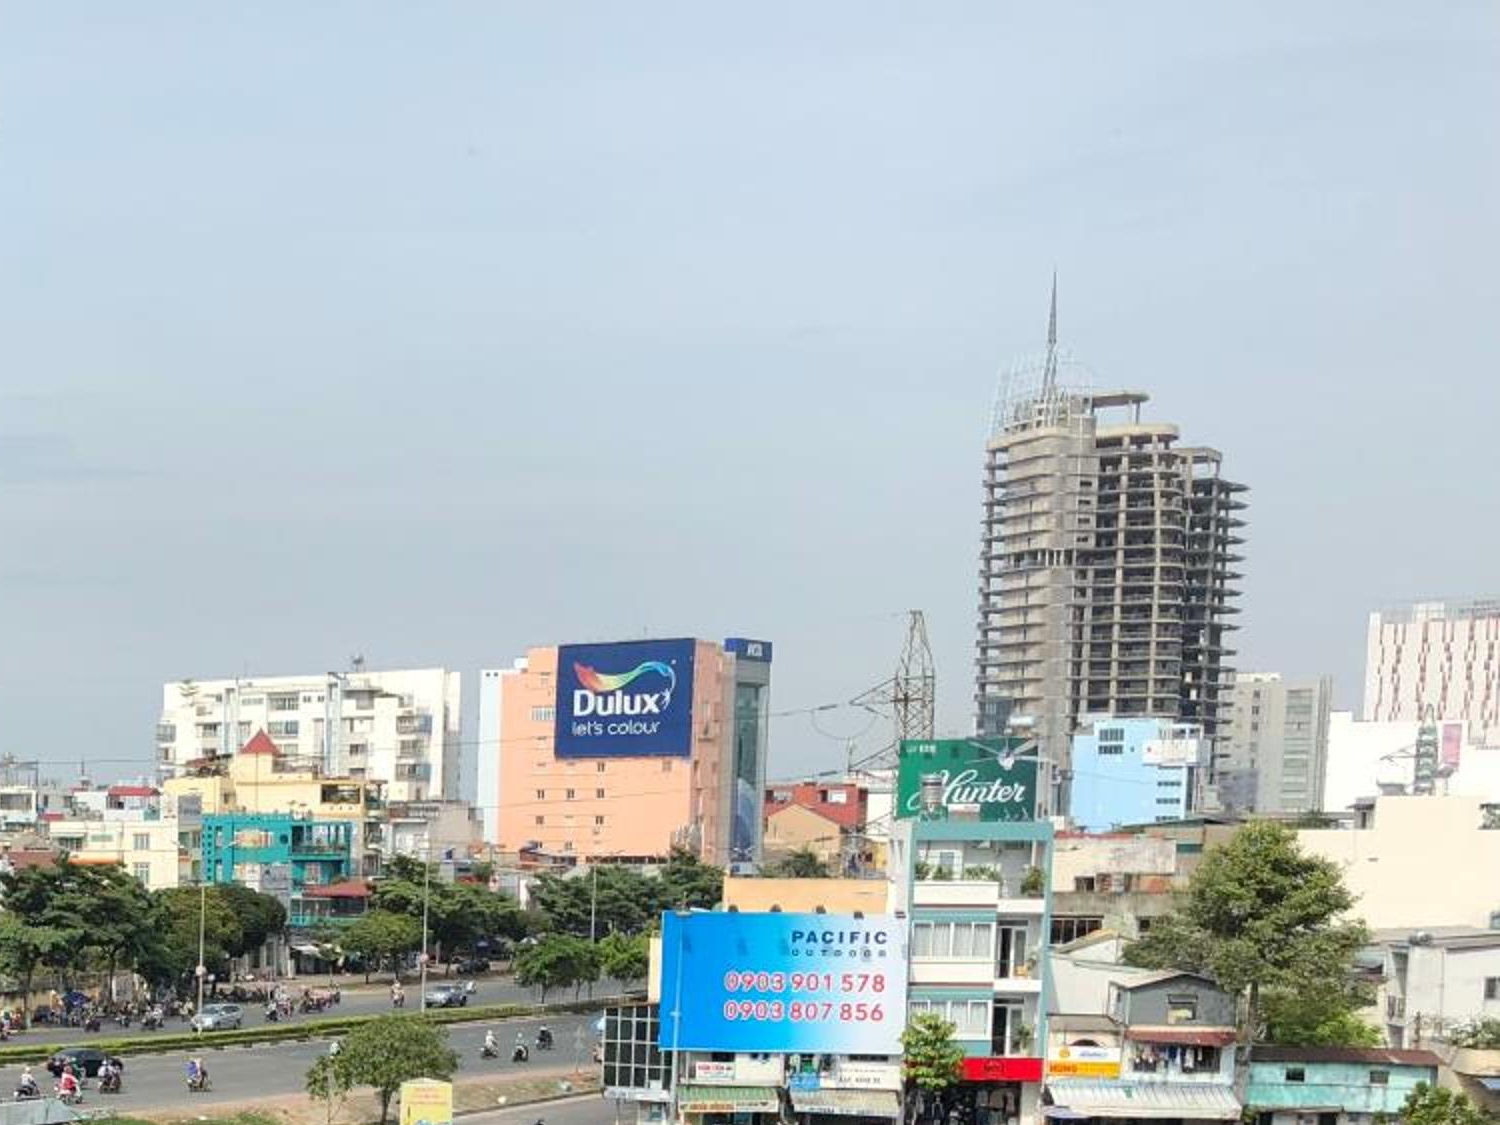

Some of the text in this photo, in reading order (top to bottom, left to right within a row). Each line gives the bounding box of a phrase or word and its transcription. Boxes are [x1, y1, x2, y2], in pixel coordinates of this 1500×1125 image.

[573, 689, 660, 717] Dulux
[571, 720, 661, 737] let's colour
[791, 931, 888, 944] PACIFIC
[791, 949, 887, 957] OUTDOOR
[725, 973, 886, 992] 0903 901 578
[725, 1001, 884, 1021] 0903 807 856
